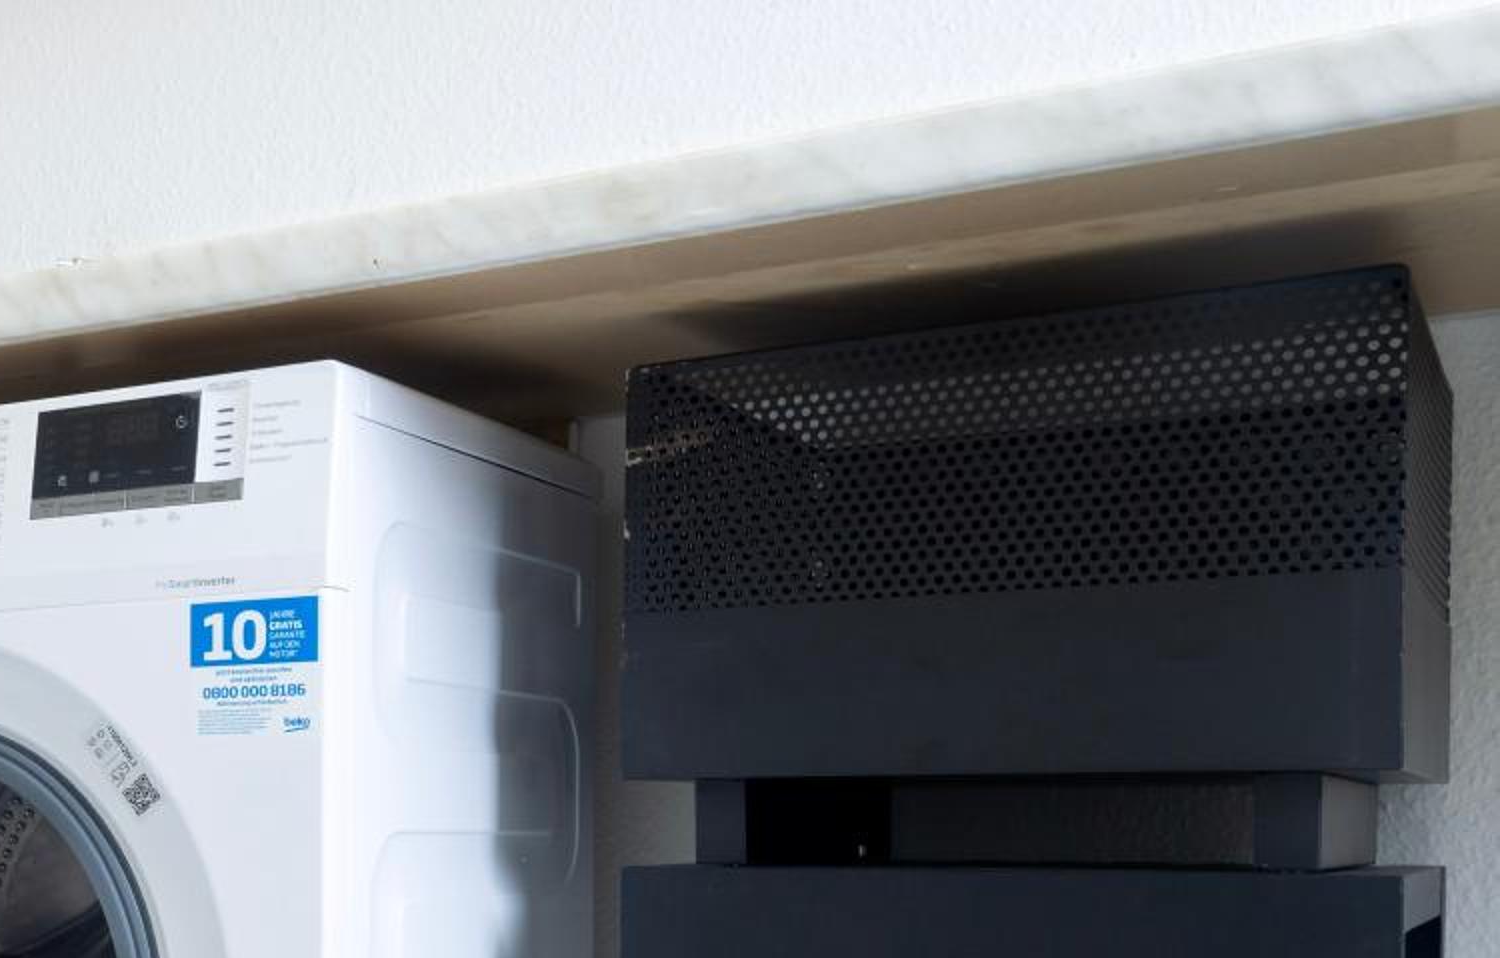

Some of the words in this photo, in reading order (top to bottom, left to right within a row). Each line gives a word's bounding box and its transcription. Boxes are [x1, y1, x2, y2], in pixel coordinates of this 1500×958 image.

[269, 610, 295, 619] JAHRE
[268, 620, 303, 631] GRATIS
[203, 609, 267, 661] 10
[203, 685, 239, 700] 0800
[241, 684, 268, 699] 000
[270, 683, 306, 698] 8186
[283, 716, 311, 729] beko
